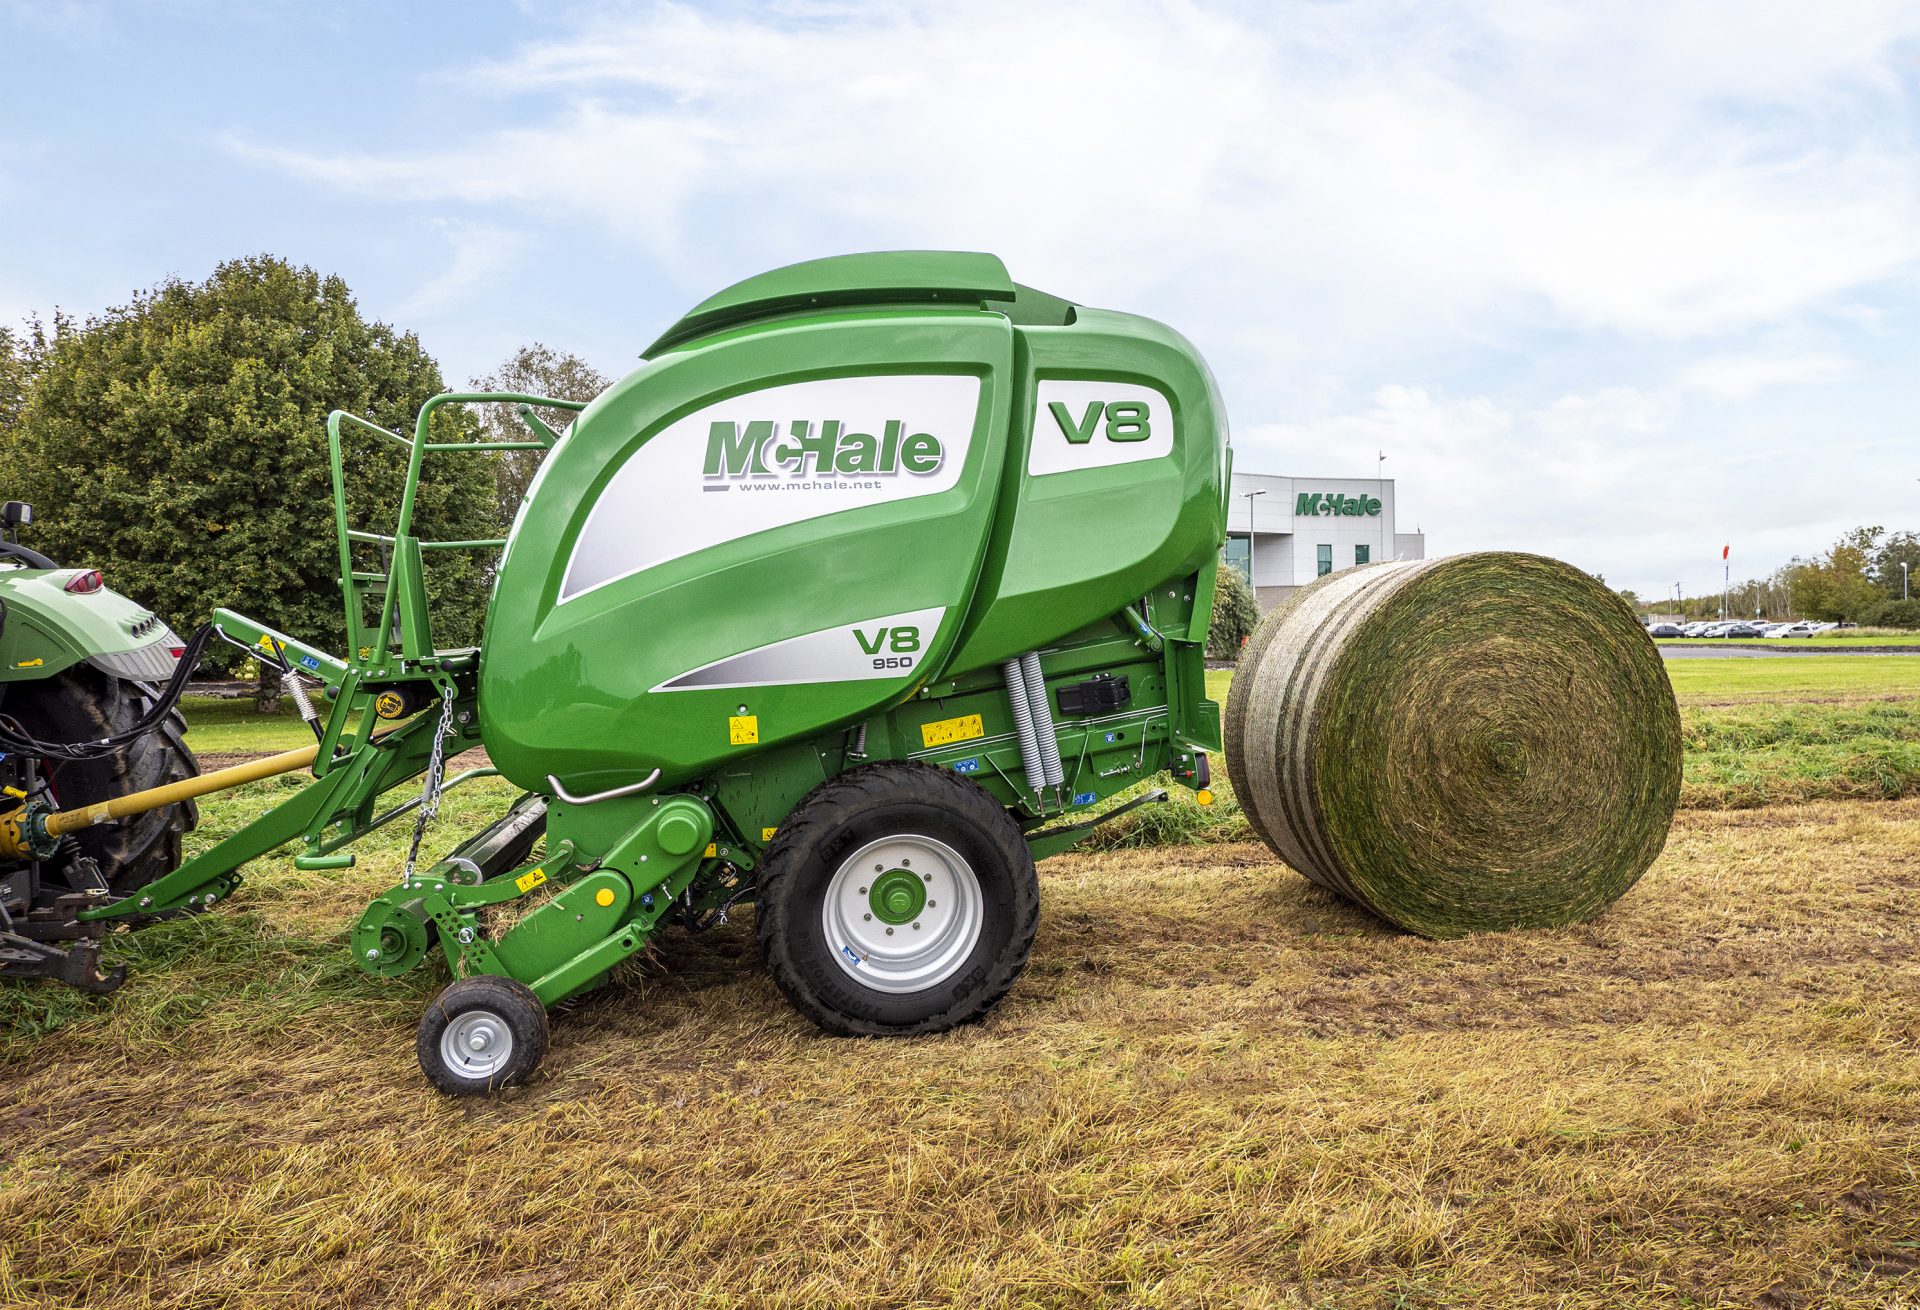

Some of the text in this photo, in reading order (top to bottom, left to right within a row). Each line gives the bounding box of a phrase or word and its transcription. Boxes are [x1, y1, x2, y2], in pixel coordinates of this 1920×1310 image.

[1048, 400, 1151, 444] V8
[702, 419, 943, 475] McHale
[739, 481, 881, 492] www.mchale.net
[1295, 493, 1382, 516] McHale
[852, 626, 920, 655] V8
[873, 656, 912, 670] 950
